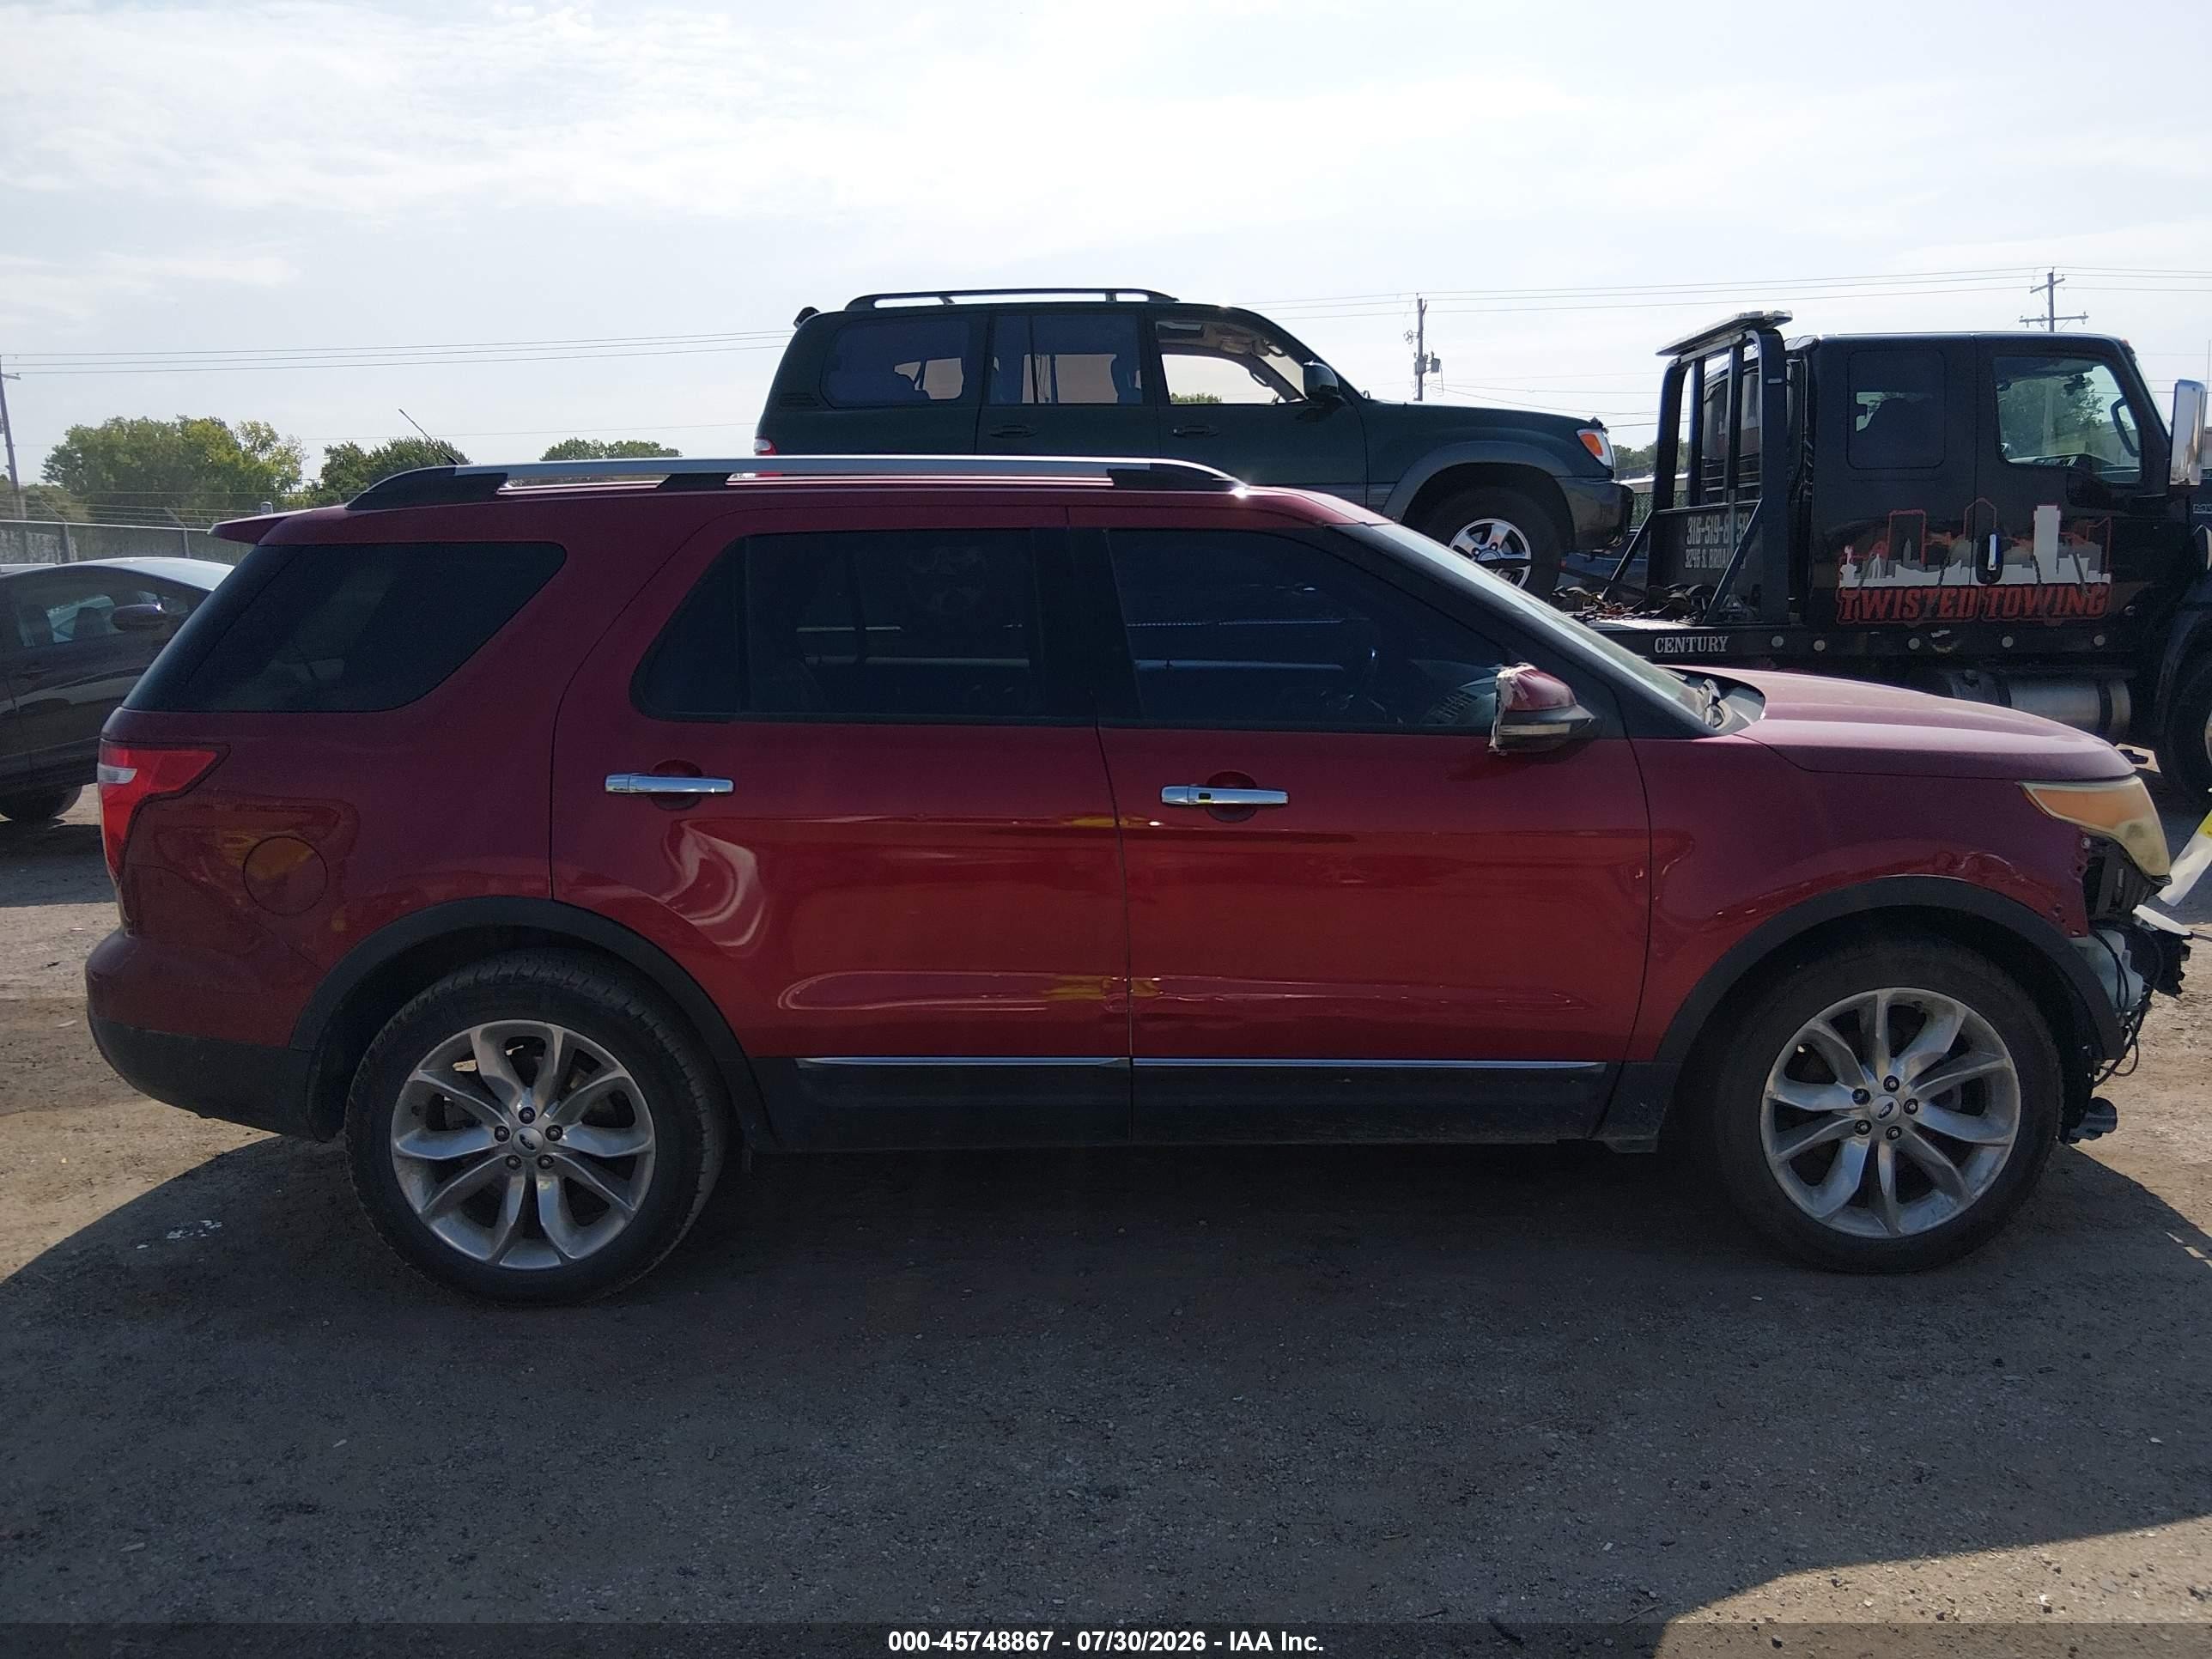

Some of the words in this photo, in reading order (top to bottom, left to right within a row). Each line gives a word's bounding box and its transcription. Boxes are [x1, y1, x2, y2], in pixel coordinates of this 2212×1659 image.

[1840, 586, 1976, 620] TWISTED
[1985, 583, 2111, 618] TOWING
[1654, 635, 1729, 653] CENTURY
